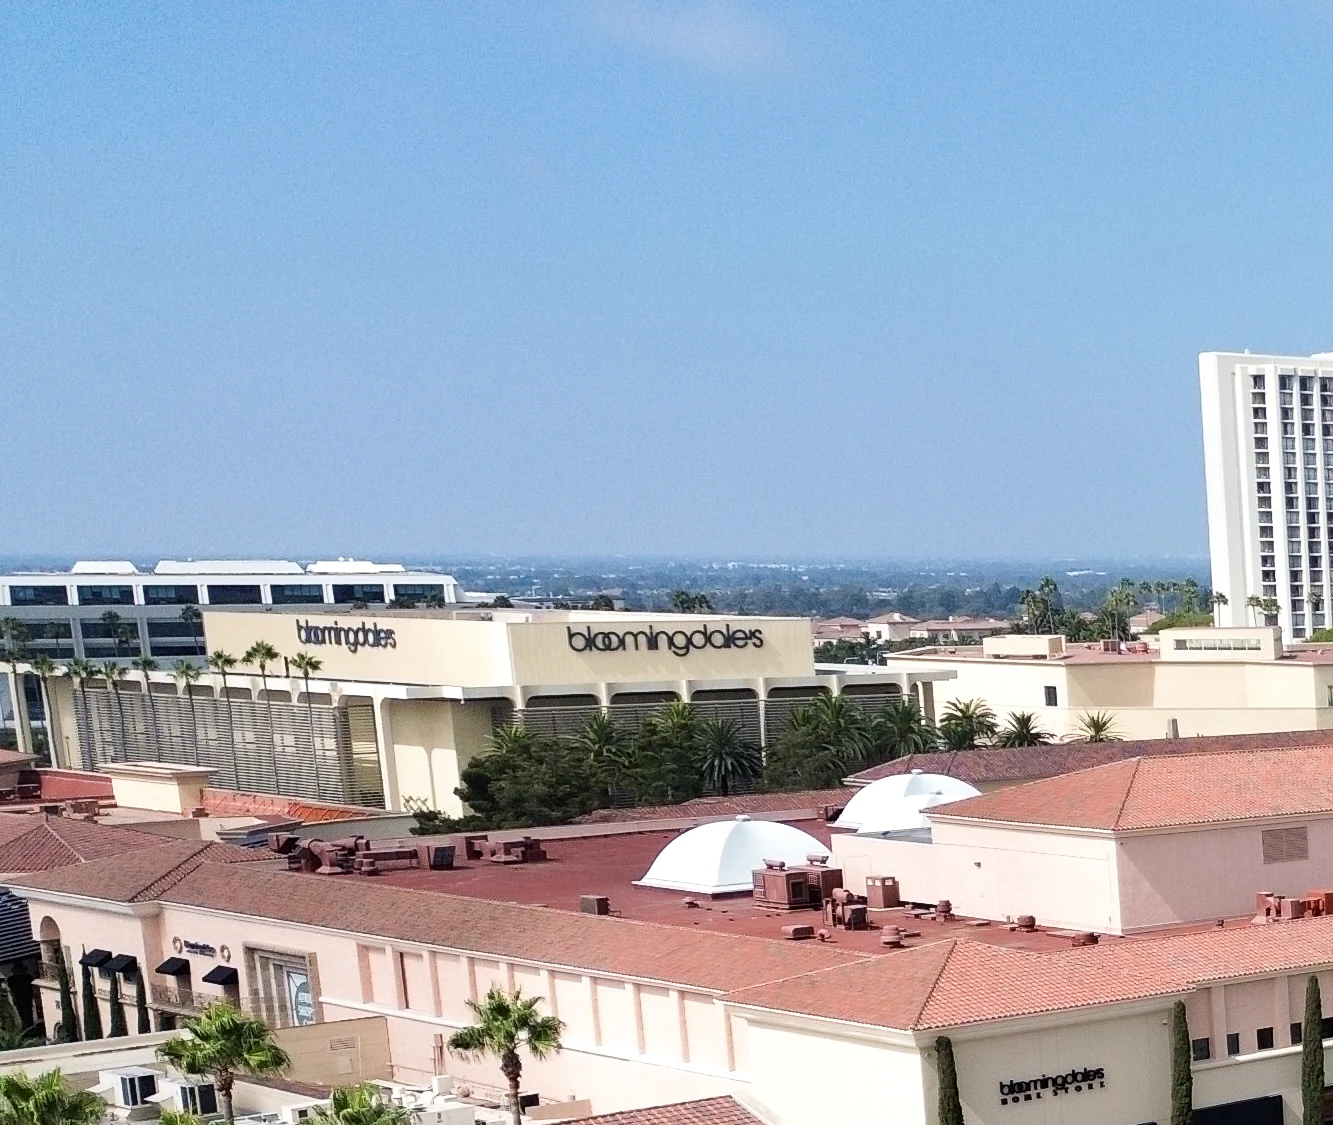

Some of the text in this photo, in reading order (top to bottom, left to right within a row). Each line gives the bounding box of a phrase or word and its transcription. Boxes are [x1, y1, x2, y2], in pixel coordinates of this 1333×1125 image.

[566, 623, 764, 657] bloomingdale's
[1001, 1081, 1105, 1105] HOME STORE
